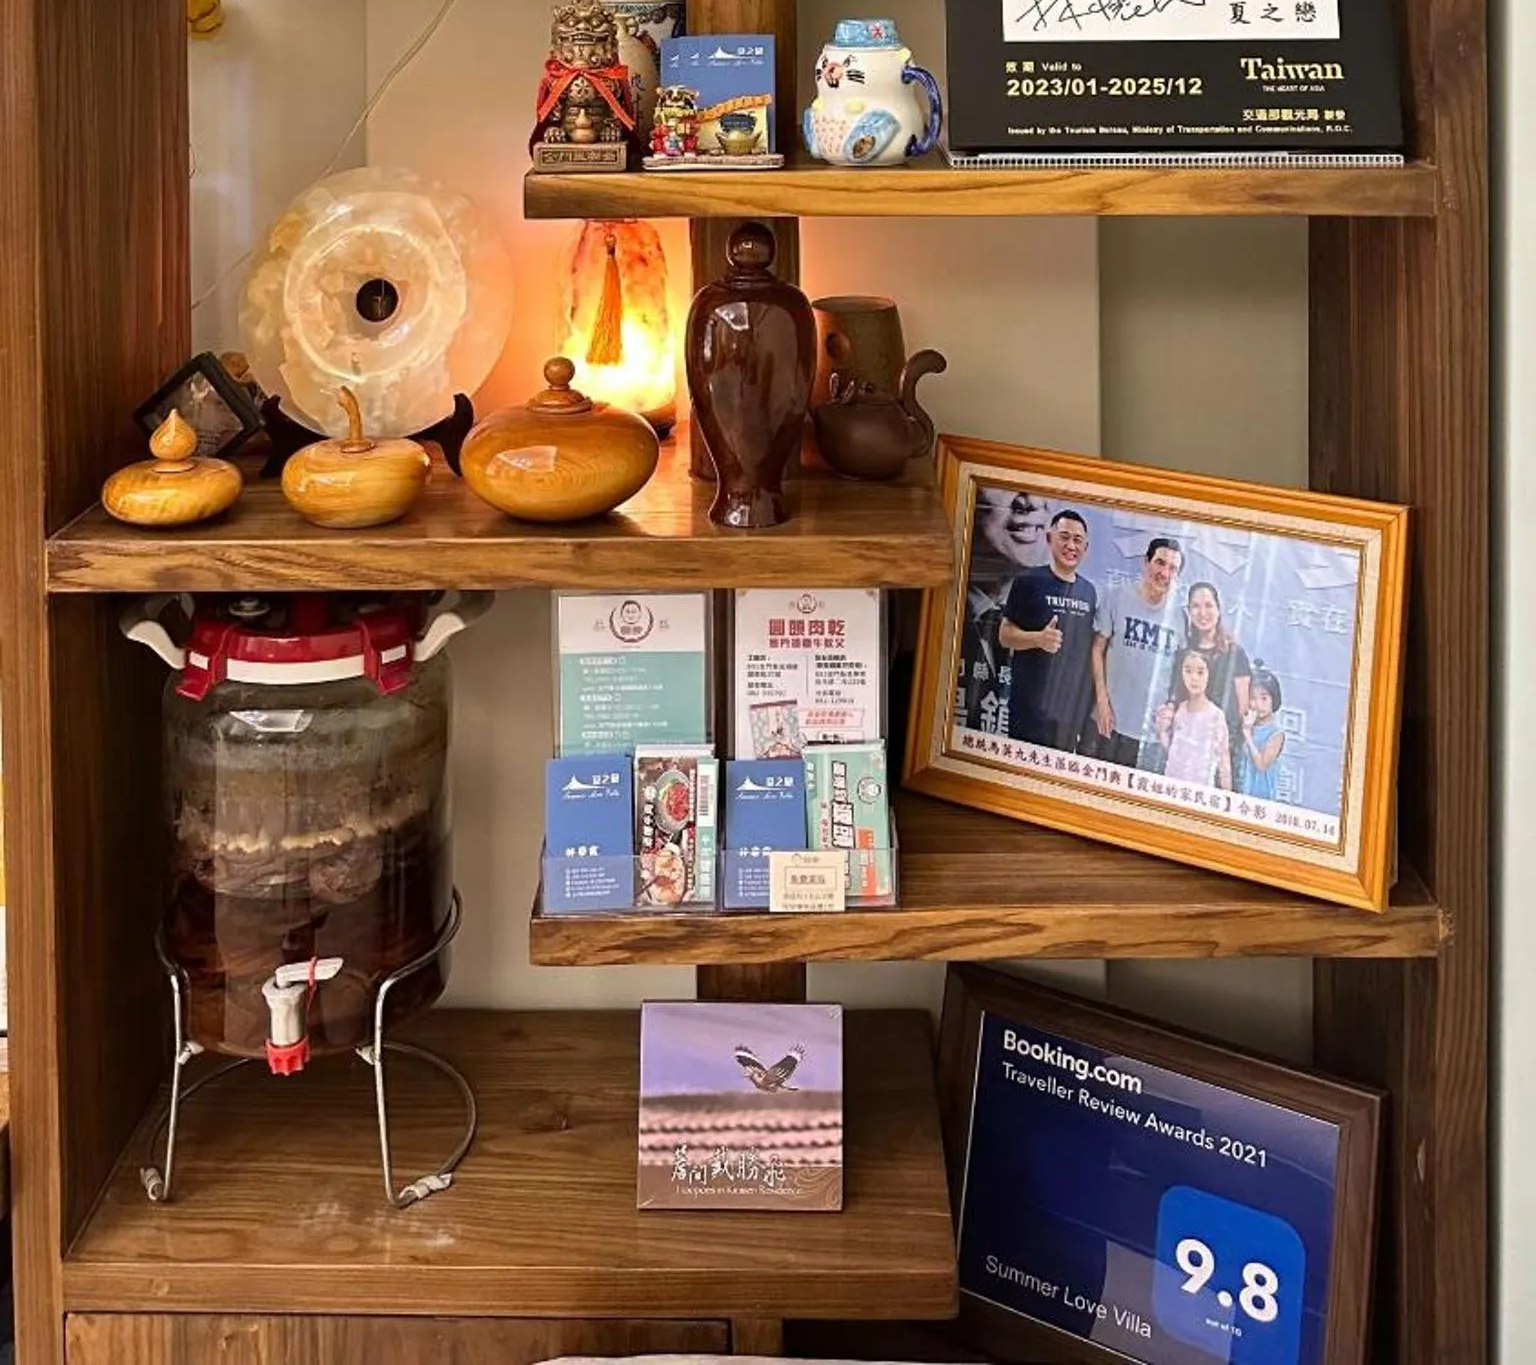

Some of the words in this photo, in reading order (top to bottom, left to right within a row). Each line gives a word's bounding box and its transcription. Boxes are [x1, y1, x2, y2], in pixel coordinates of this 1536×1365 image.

[1228, 1, 1317, 24] 夏之戀
[1041, 62, 1068, 72] Valid
[1072, 62, 1082, 72] to
[1240, 57, 1344, 80] Taiwan
[1006, 77, 1203, 96] 2023/01-2025/12
[1124, 616, 1175, 650] KMT
[1003, 1029, 1143, 1094] Booking.com
[1002, 1061, 1074, 1099] Traveller
[1078, 1088, 1141, 1125] Review
[1144, 1113, 1215, 1150] Awards
[1218, 1137, 1267, 1167] 2021
[1175, 1238, 1279, 1323] 9.8
[985, 1254, 1059, 1297] Summer
[1063, 1287, 1107, 1319] Love
[1112, 1305, 1151, 1338] Villa
[1231, 1326, 1242, 1337] 10
